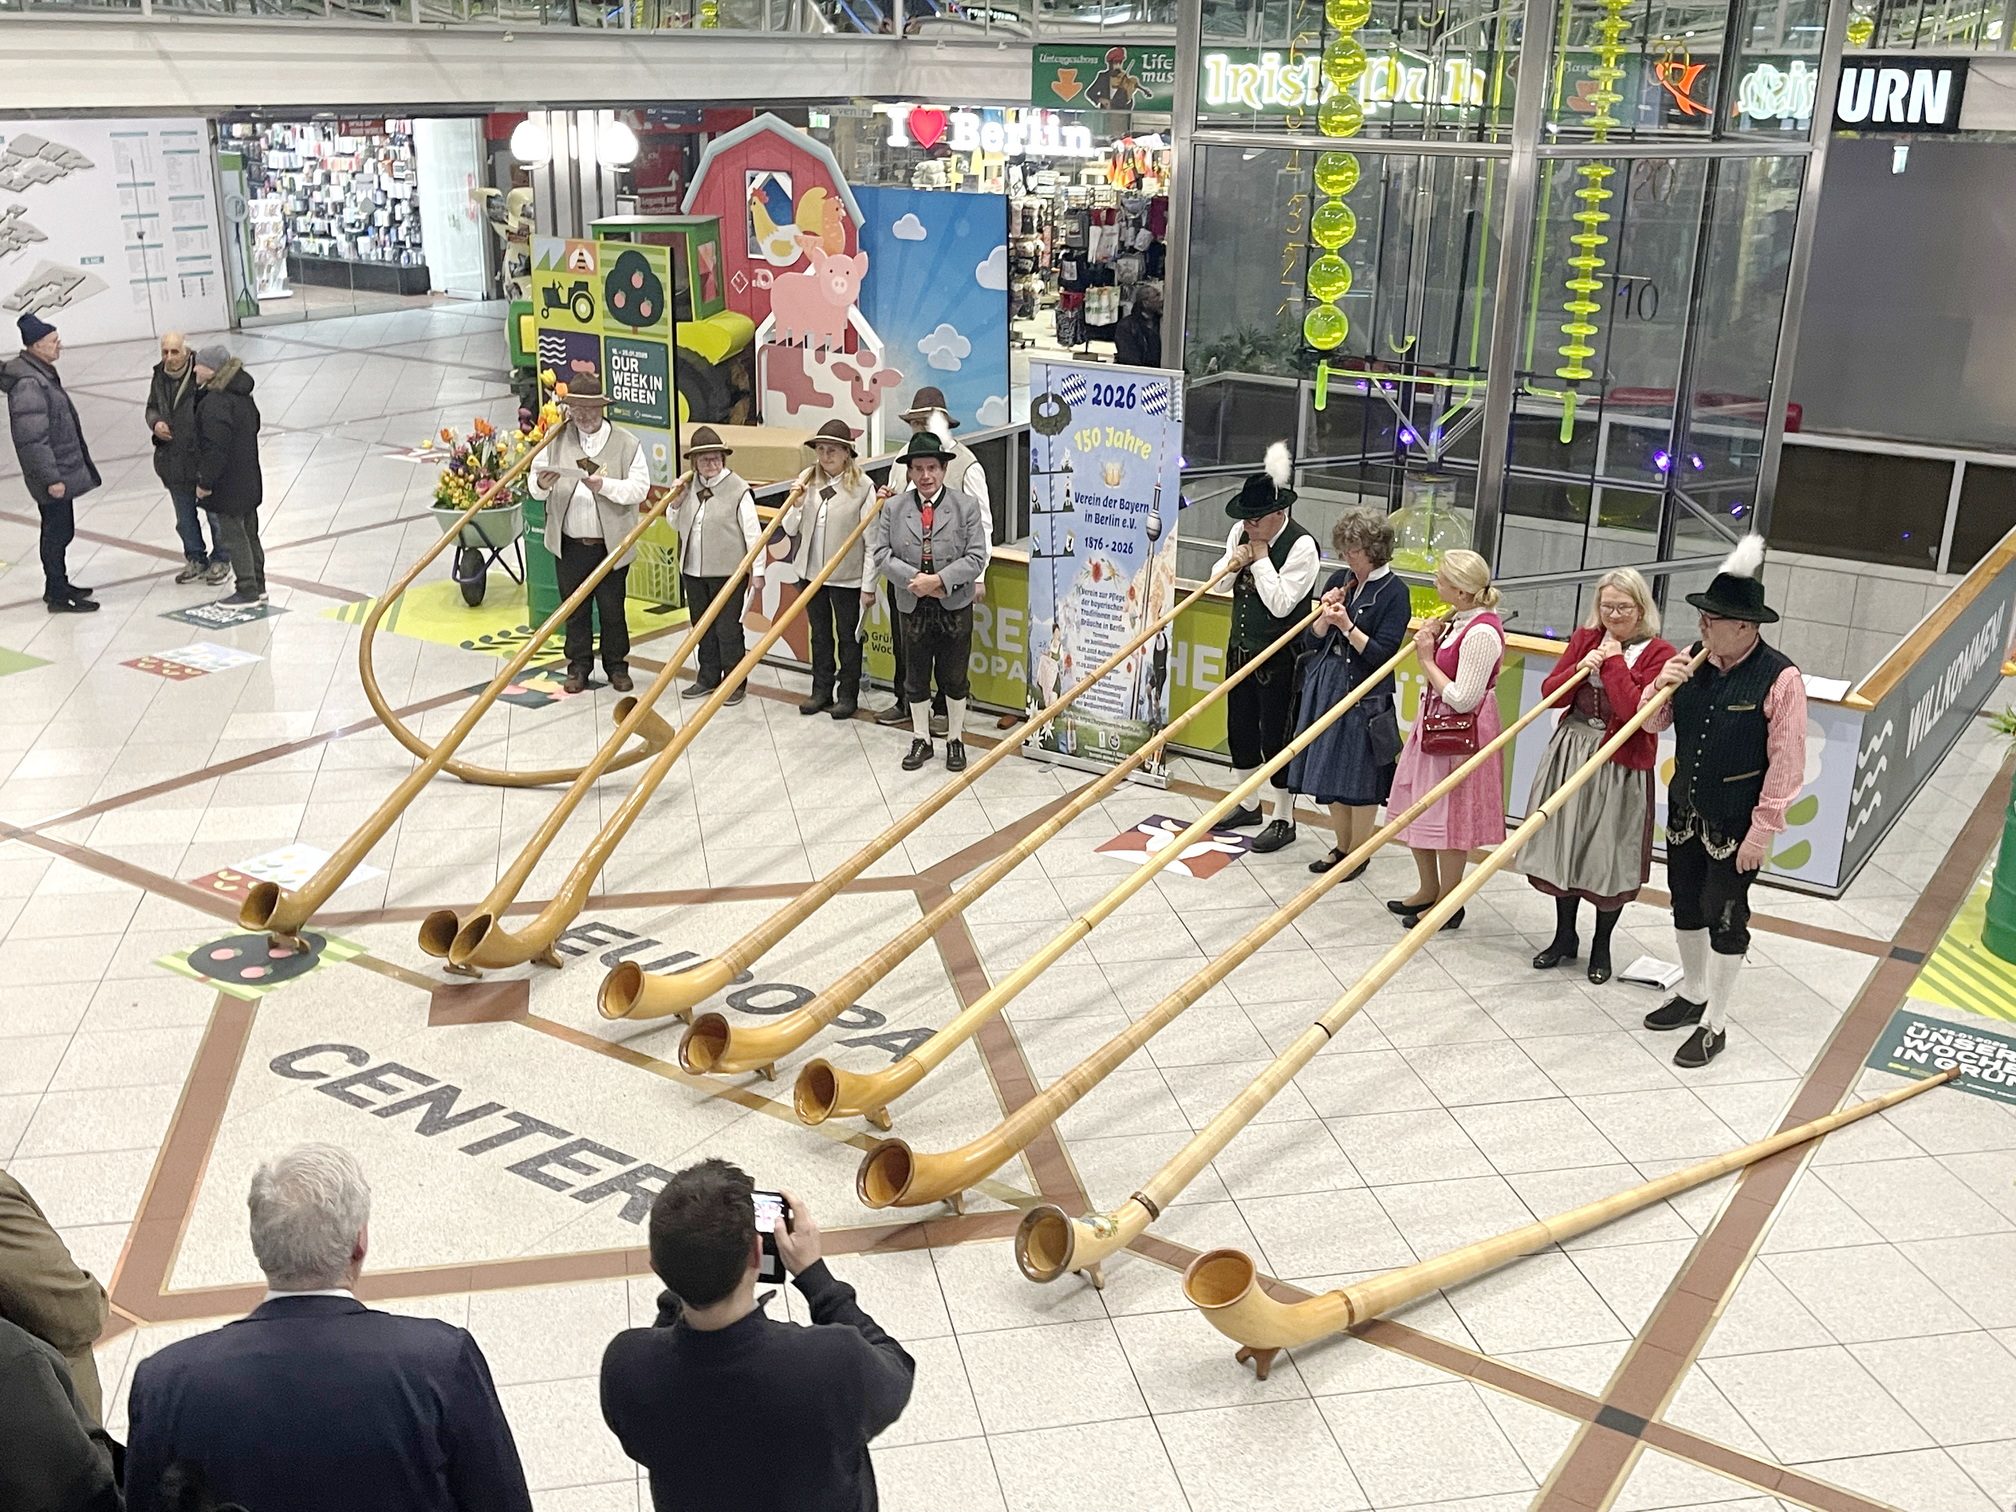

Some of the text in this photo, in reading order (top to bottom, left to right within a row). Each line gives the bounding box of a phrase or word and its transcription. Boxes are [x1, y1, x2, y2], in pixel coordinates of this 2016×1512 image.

[1141, 53, 1174, 70] Life
[1141, 71, 1175, 83] mus
[1837, 68, 1952, 124] URN
[887, 105, 1096, 157] I Berlin
[1618, 277, 1659, 321] 10
[612, 355, 639, 373] OUR
[612, 371, 663, 391] WEEK IN
[613, 385, 656, 405] GREEN
[1092, 383, 1137, 409] 2026
[1074, 426, 1152, 460] 150 Jahre
[1074, 492, 1150, 514] Verein der Bayern
[1084, 510, 1137, 530] in Berlin e.V.
[1084, 537, 1103, 549] 1876
[1111, 541, 1134, 554] 2026
[1108, 593, 1126, 603] Pflege
[1109, 623, 1126, 633] Berlin
[1905, 600, 2006, 759] WILLKOMMEN
[1906, 1025, 2016, 1062] UNSER
[1893, 1046, 1929, 1064] IN
[269, 1043, 674, 1225] CENTER
